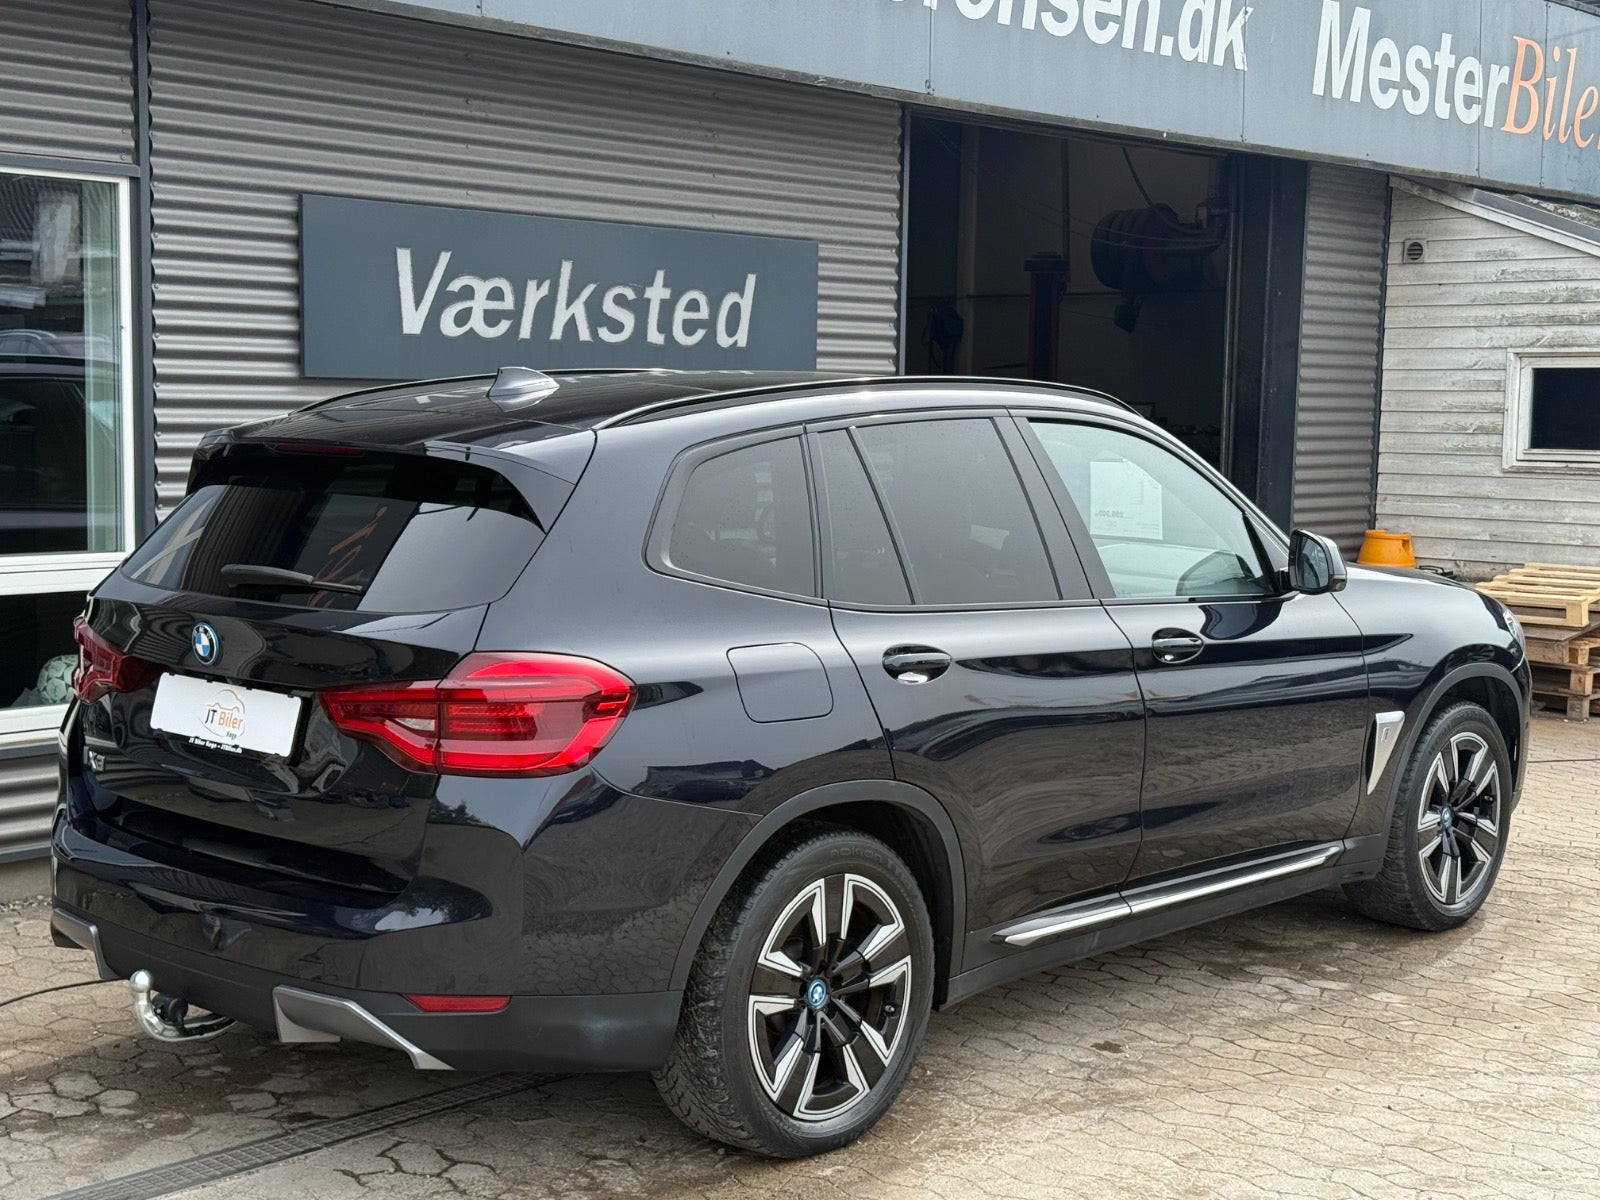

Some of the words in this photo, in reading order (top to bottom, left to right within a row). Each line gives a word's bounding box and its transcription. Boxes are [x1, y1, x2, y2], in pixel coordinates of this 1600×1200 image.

[1312, 0, 1600, 149] MesterBile
[396, 247, 757, 348] Værksted
[205, 708, 218, 724] JT
[218, 710, 244, 730] Biler
